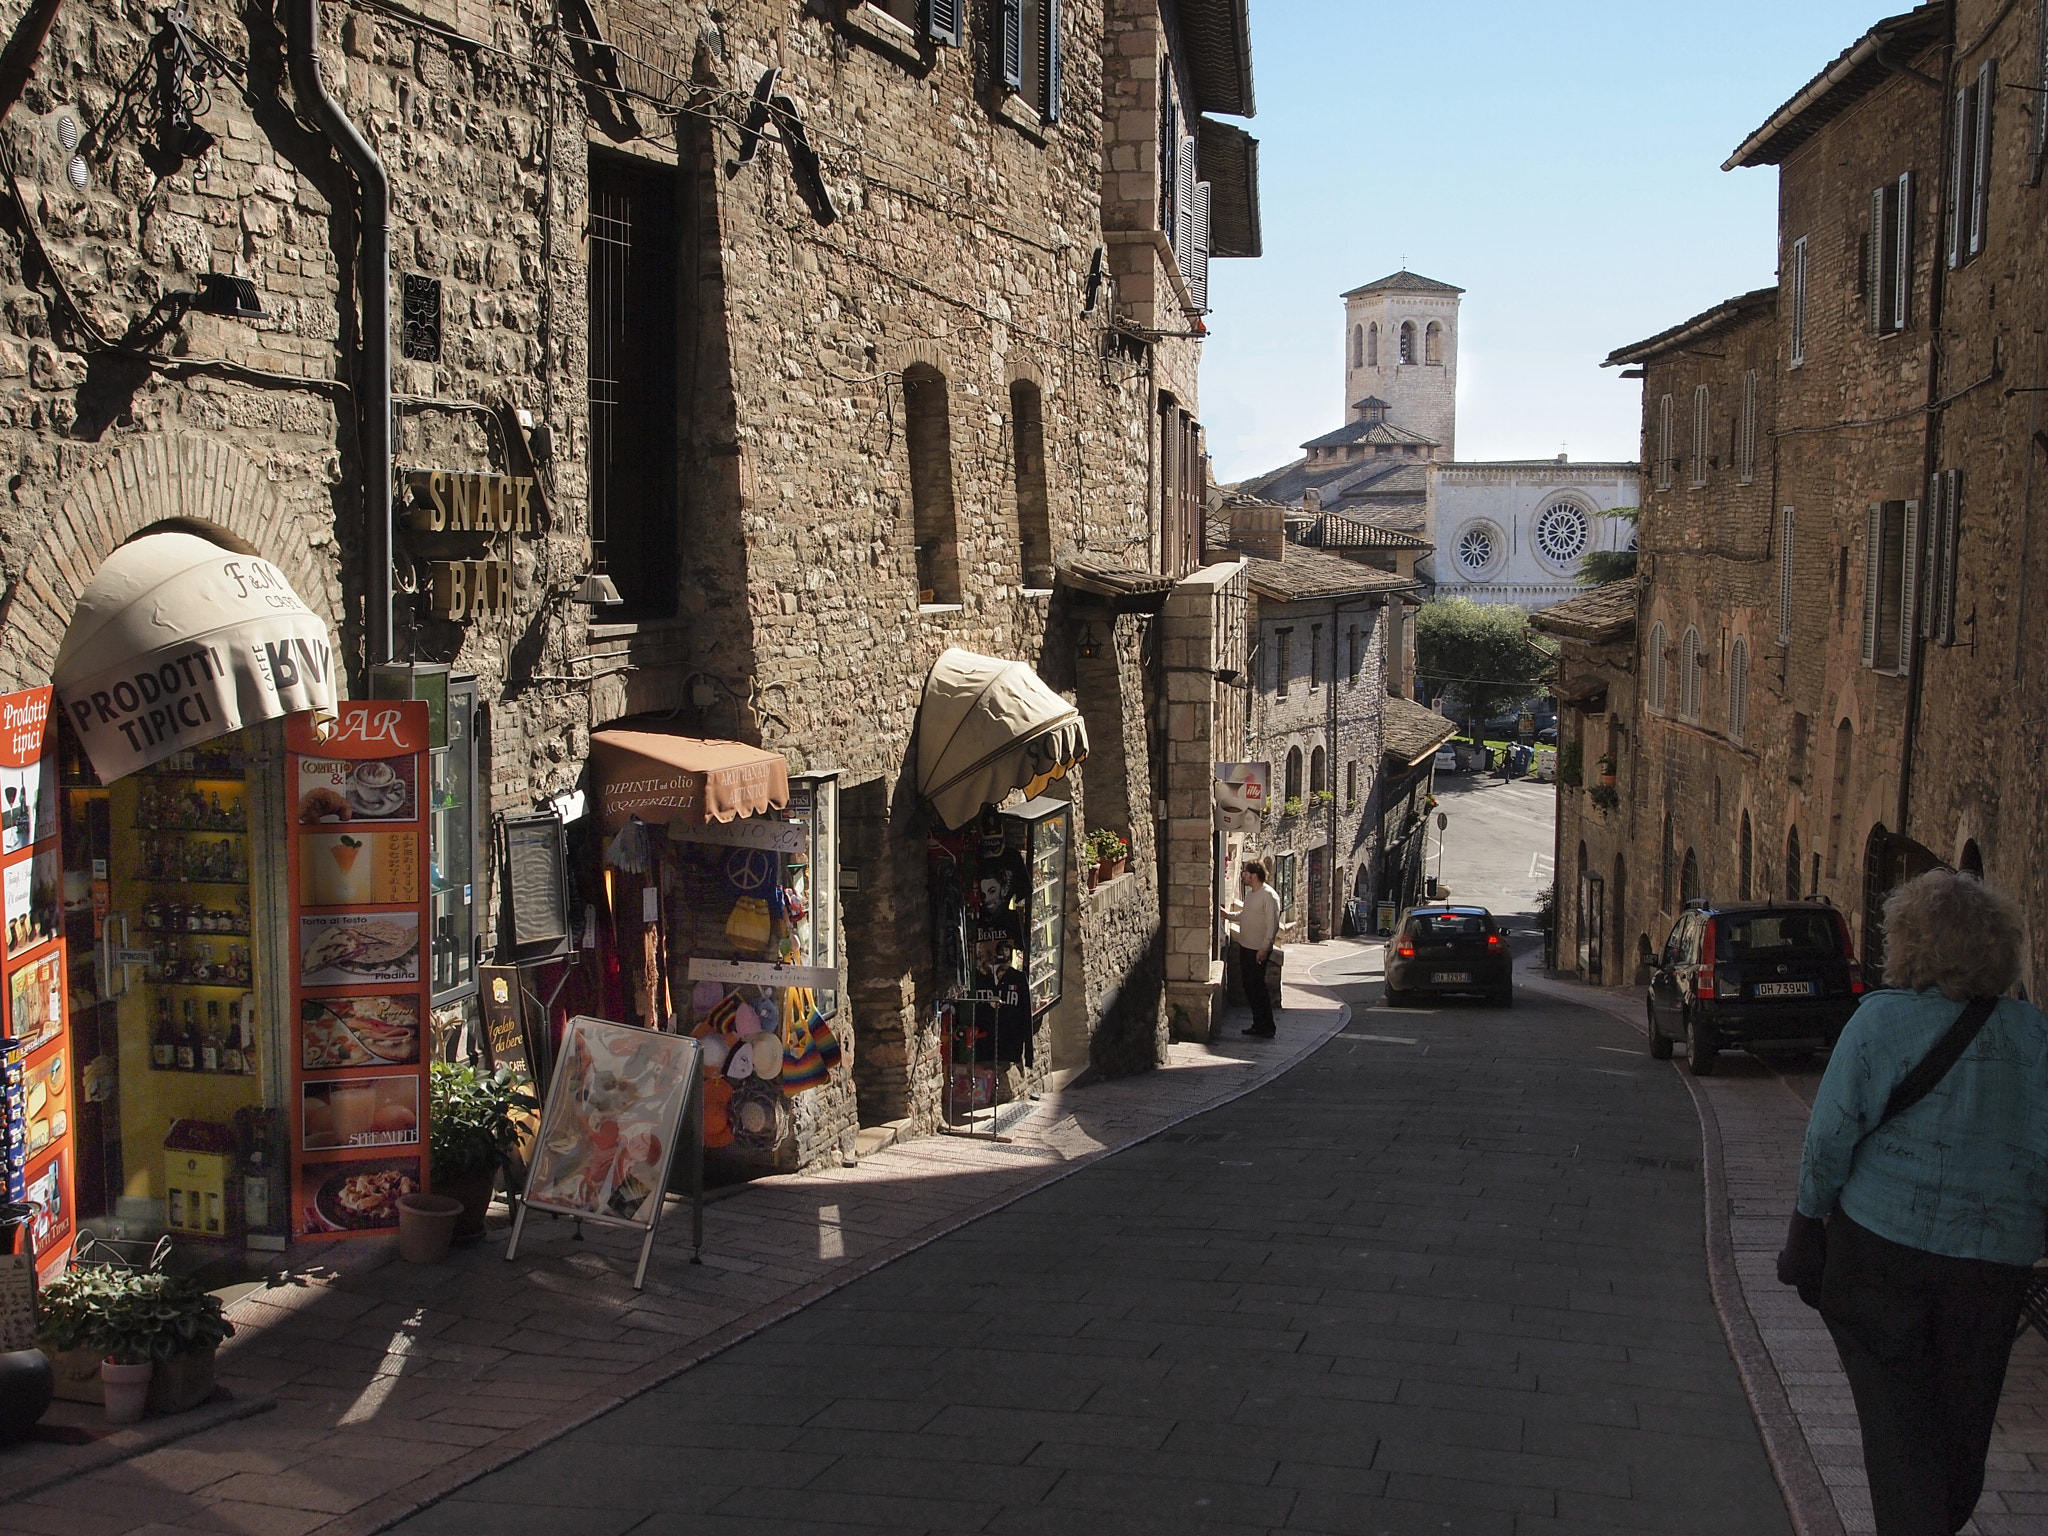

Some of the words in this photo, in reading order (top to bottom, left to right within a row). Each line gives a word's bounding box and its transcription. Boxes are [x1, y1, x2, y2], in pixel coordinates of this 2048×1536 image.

[429, 470, 533, 532] SNACK
[449, 562, 513, 622] BAR
[70, 647, 225, 732] PRODOTTI
[3, 696, 48, 730] Prodotti
[118, 693, 213, 753] TIPICI
[12, 724, 42, 764] tipici
[331, 774, 344, 785] &
[604, 778, 660, 796] DIPINTI
[660, 782, 668, 790] ad
[670, 776, 693, 789] olio
[1247, 785, 1261, 798] illy
[604, 796, 694, 817] ACQUERELLI
[302, 918, 327, 926] Torta
[330, 917, 339, 925] al
[977, 928, 1008, 941] BEATLES
[375, 971, 415, 981] Piadina
[1761, 984, 1773, 994] DH
[1776, 983, 1808, 993] 739WN
[491, 1015, 515, 1044] gelato
[496, 1036, 504, 1053] da
[506, 1031, 523, 1050] bere
[51, 1217, 70, 1240] TIPICI
